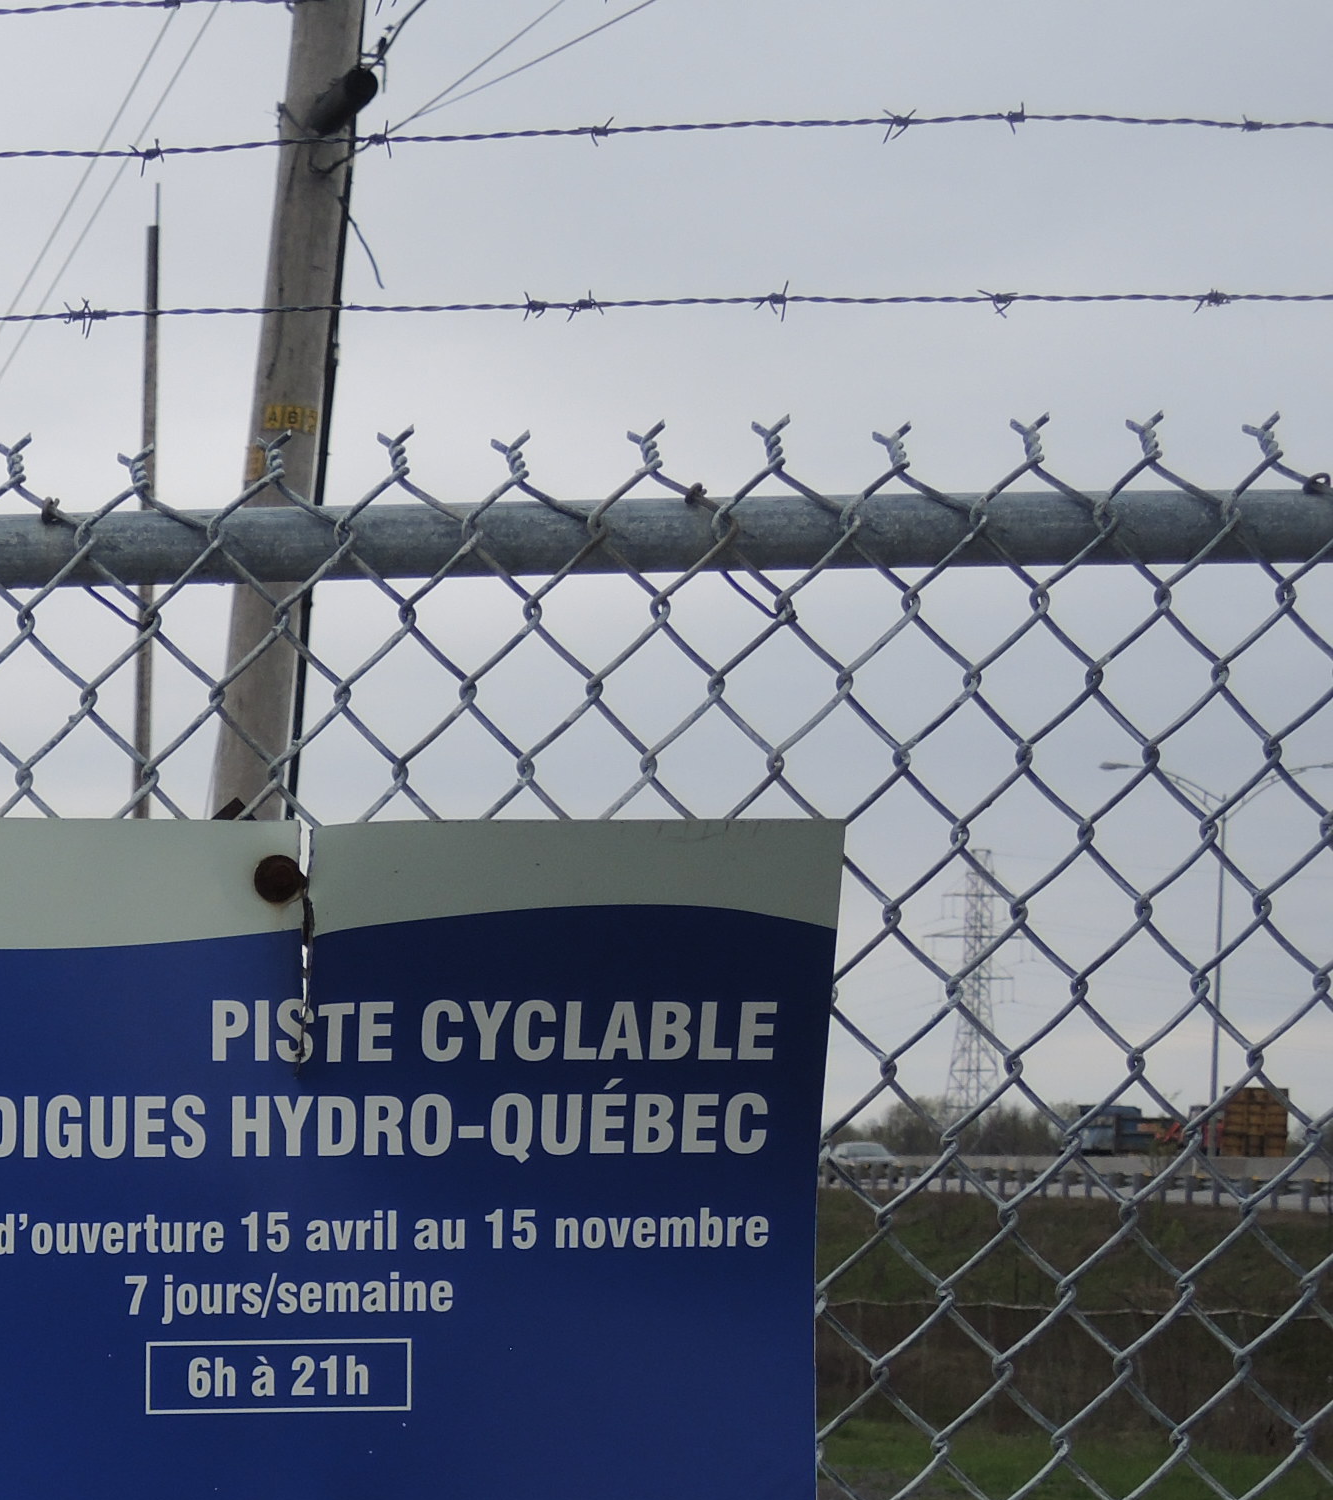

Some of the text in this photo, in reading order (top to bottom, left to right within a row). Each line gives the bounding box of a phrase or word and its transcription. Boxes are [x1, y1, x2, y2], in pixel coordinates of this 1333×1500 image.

[212, 998, 778, 1063] PISTE CYCLABLE
[231, 1078, 769, 1164] HYDRO-QUÉBEC
[241, 1211, 290, 1253] 15
[305, 1209, 397, 1252] avril
[413, 1218, 466, 1251] au
[484, 1208, 537, 1250] 15
[555, 1207, 770, 1249] novembre
[124, 1271, 454, 1325] 7 jours/semaine
[188, 1355, 370, 1398] 6h à 21h
